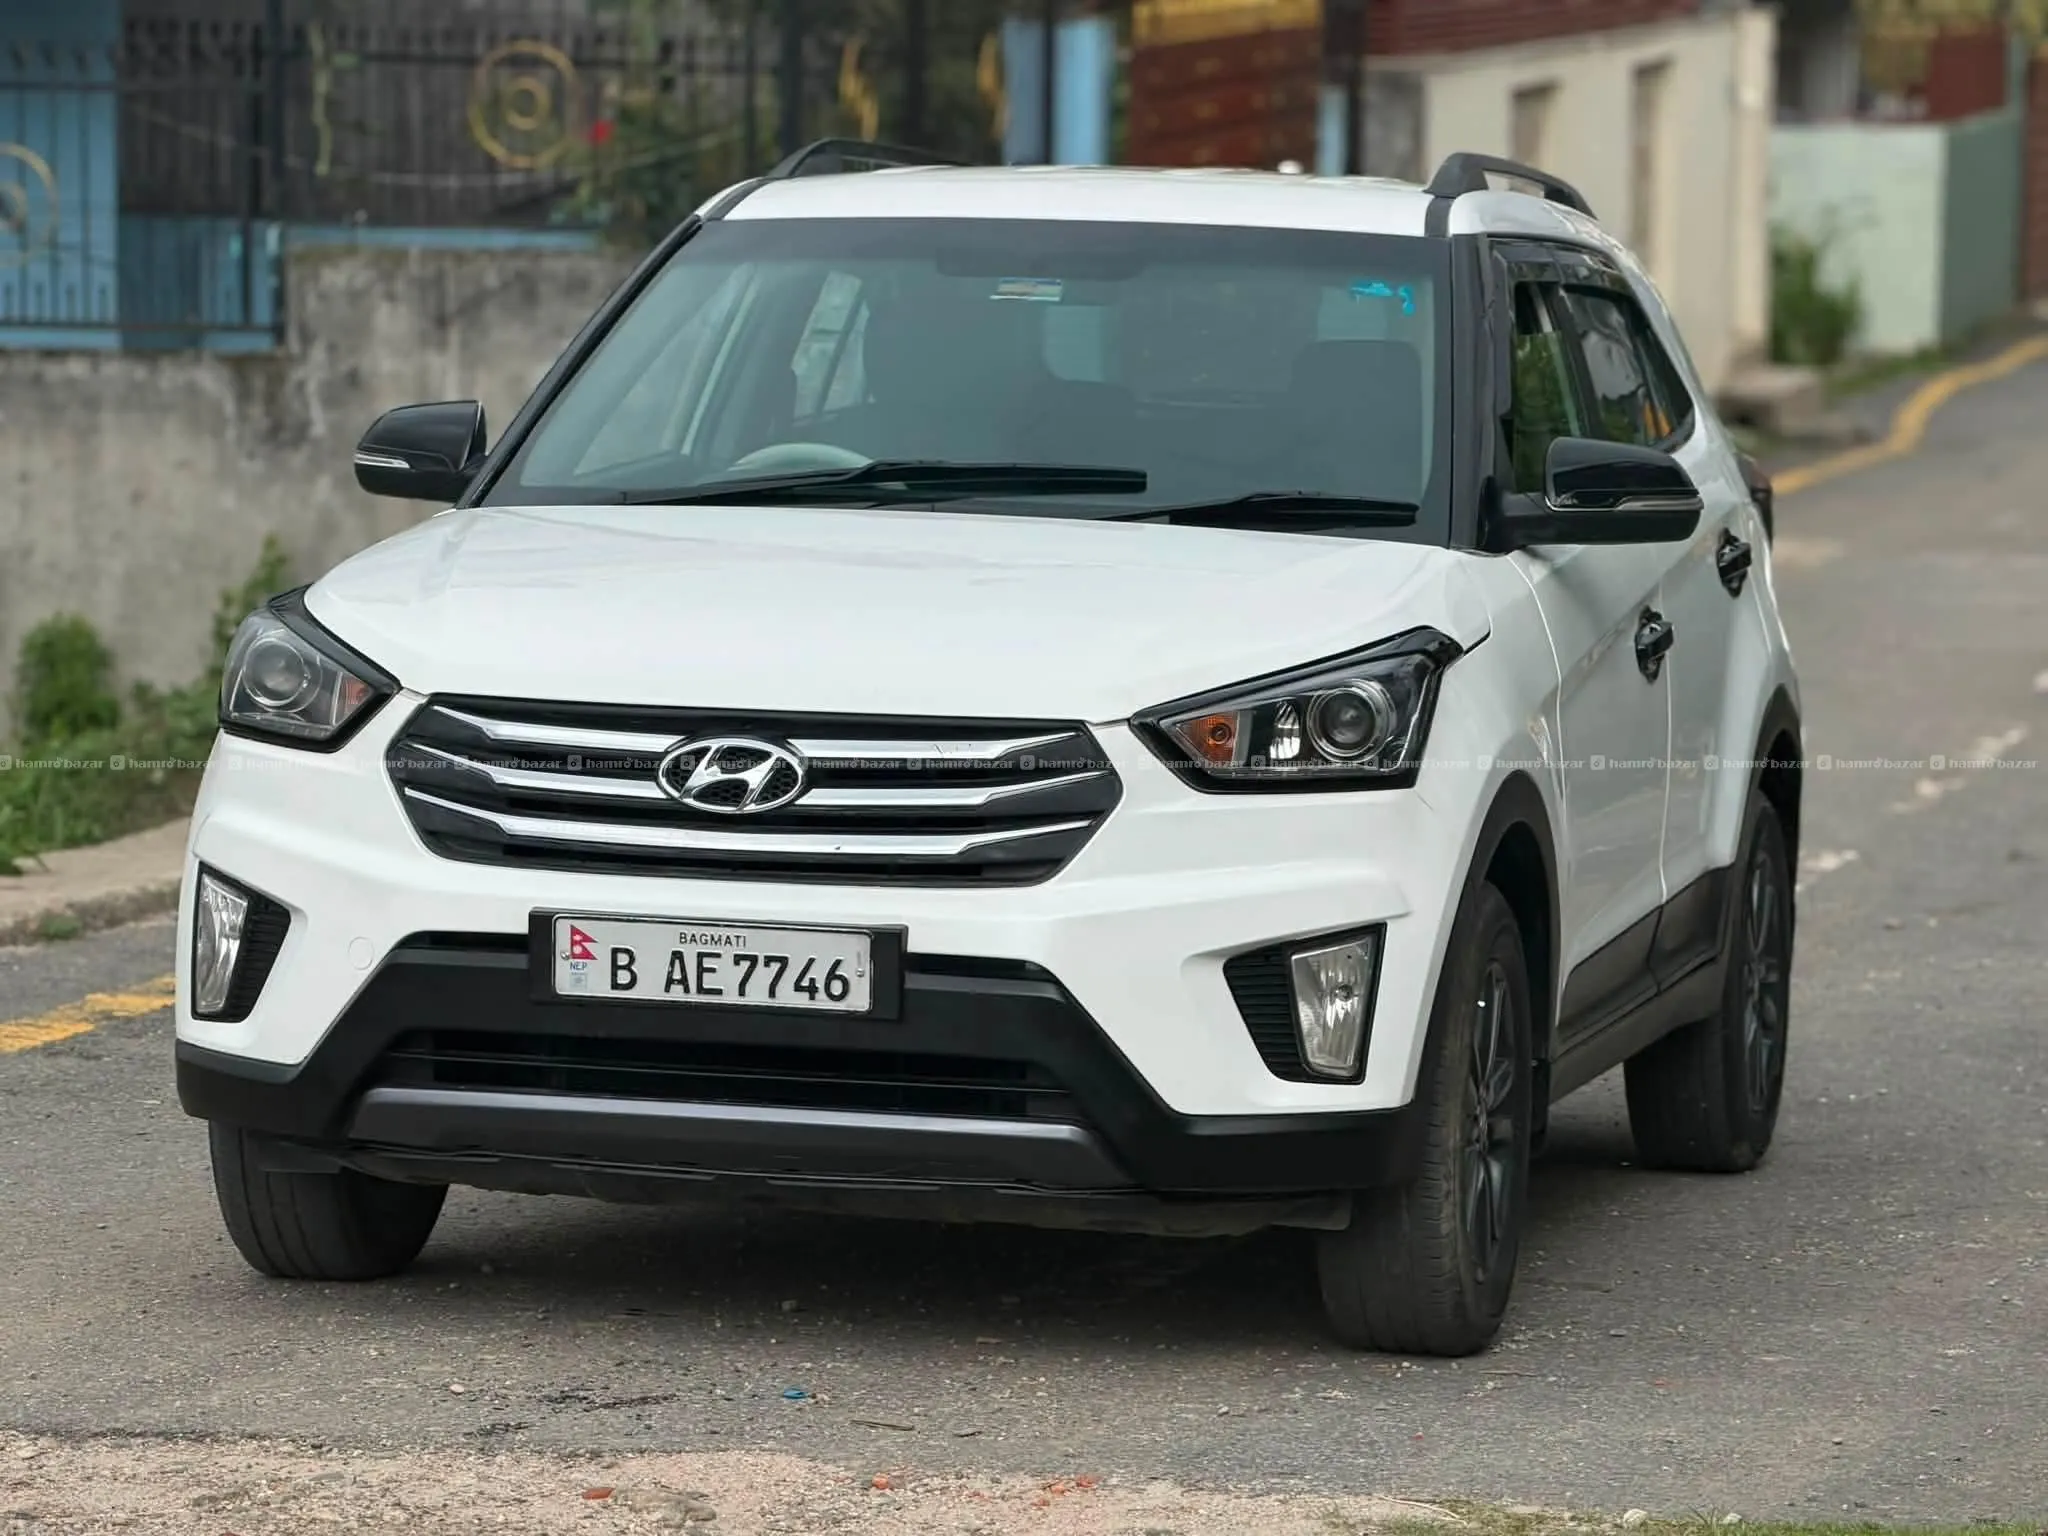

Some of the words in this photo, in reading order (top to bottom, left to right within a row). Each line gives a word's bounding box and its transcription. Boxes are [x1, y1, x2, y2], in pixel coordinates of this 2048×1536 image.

[679, 931, 747, 948] BAGMATI
[569, 961, 588, 971] NEP
[609, 947, 638, 991] B
[664, 949, 851, 1002] AE7746
